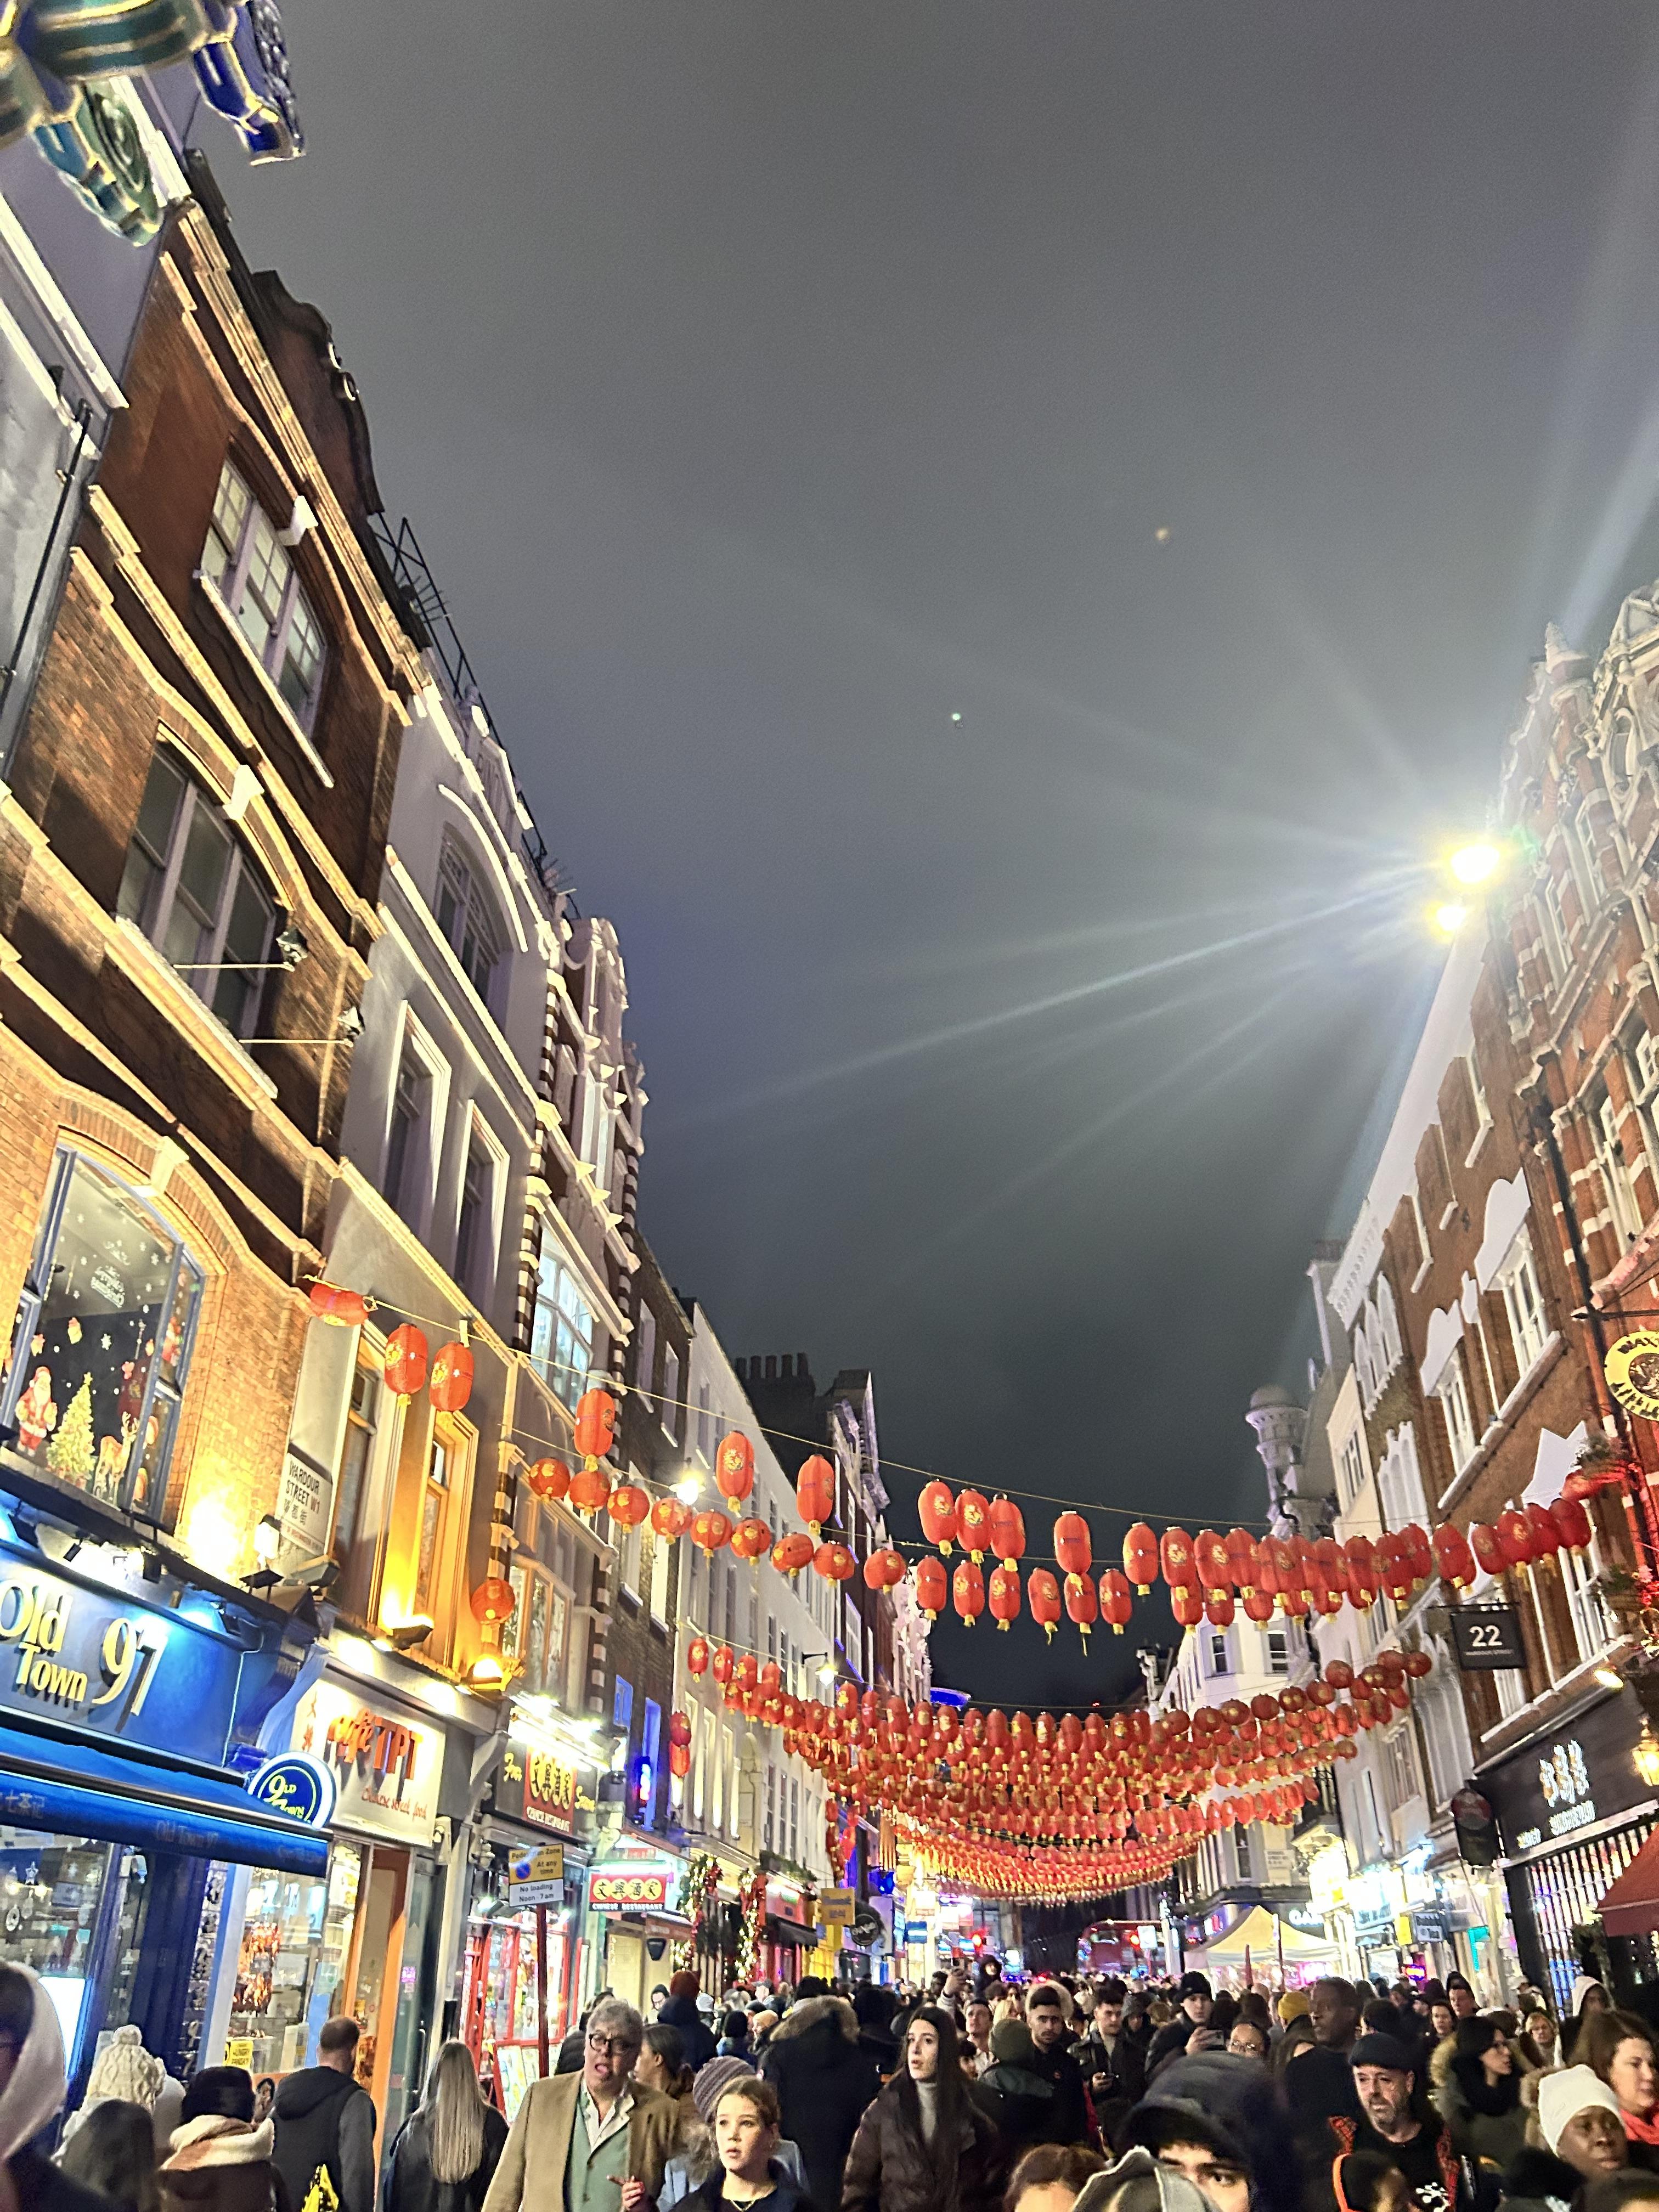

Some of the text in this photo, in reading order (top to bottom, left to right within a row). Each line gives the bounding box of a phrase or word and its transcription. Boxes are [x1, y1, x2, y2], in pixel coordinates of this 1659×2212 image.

[286, 1480, 320, 1514] STREET W1
[289, 1460, 320, 1495] WARDOUR
[0, 1579, 73, 1653] Old
[1469, 1625, 1503, 1646] 22
[16, 1641, 88, 1702] Town
[92, 1617, 168, 1717] 97
[373, 1717, 424, 1780] TPT
